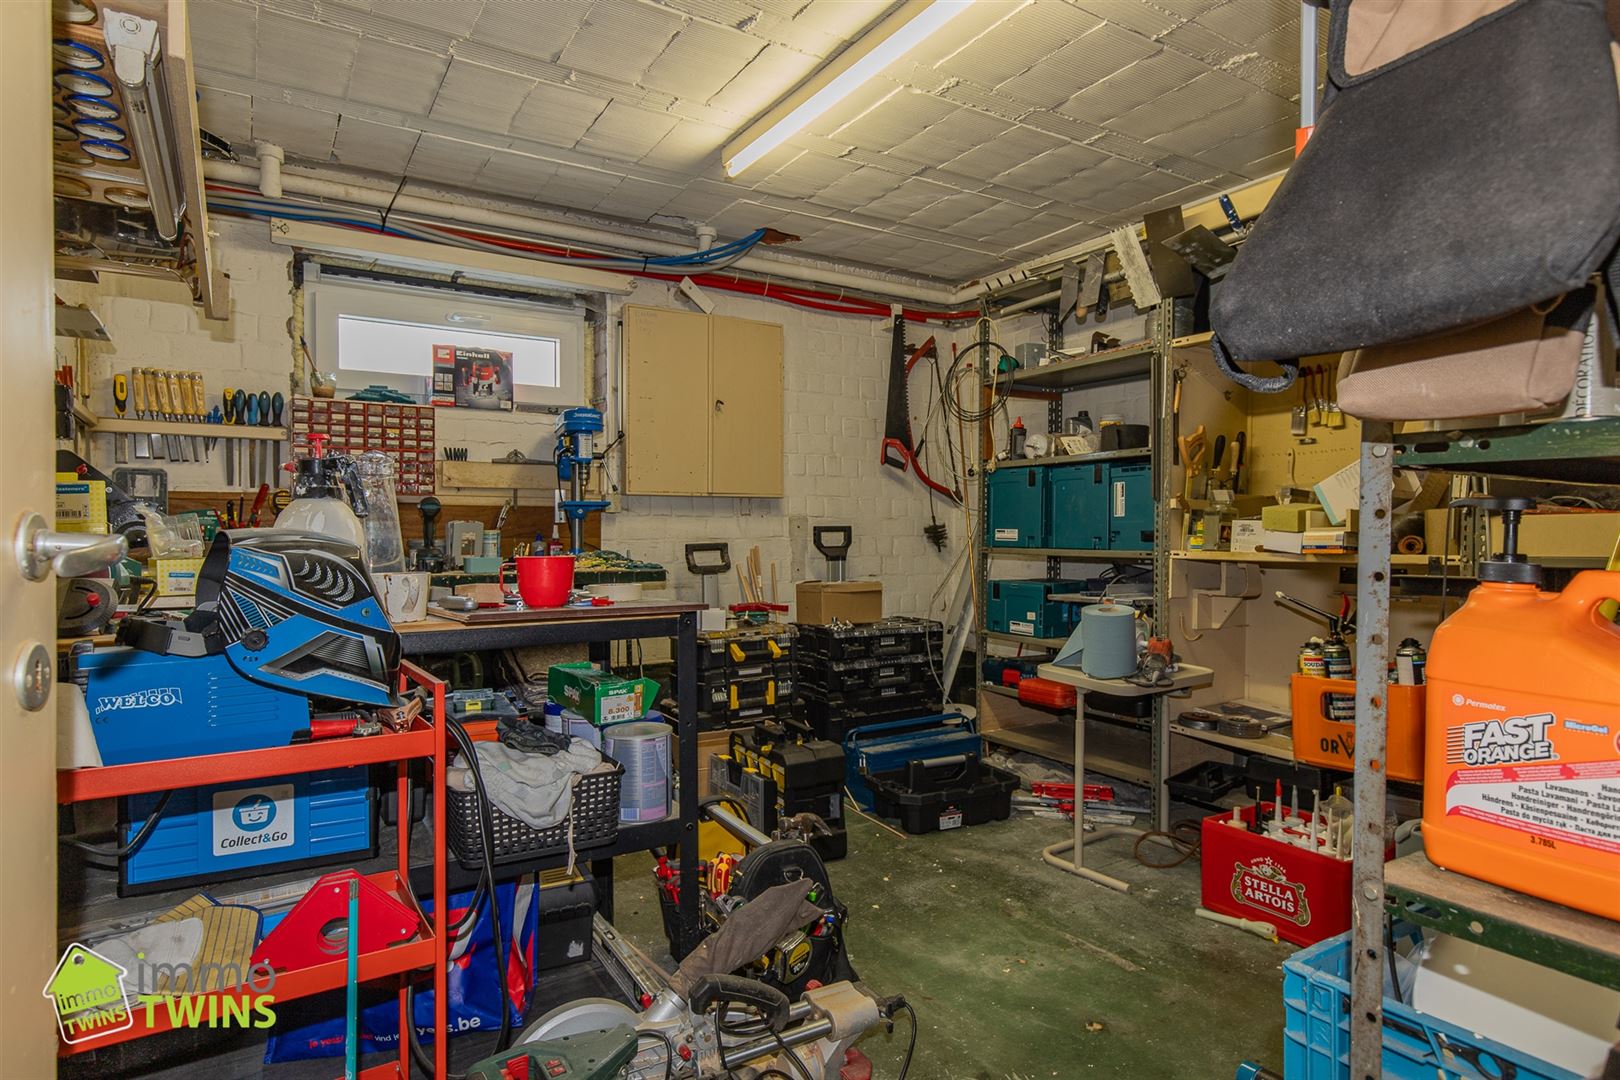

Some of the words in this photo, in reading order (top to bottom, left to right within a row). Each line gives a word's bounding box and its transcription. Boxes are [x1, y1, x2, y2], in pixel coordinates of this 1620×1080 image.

[455, 350, 490, 359] Einhell
[96, 689, 180, 713] WELCO
[1463, 714, 1555, 751] FAST
[1462, 742, 1553, 767] ORANGE
[1518, 785, 1540, 797] Pasta
[1541, 790, 1579, 805] Lavamani
[1586, 799, 1610, 811] Pasta
[1544, 782, 1589, 798] Lavamanos
[1511, 792, 1560, 810] Handreiniger
[1500, 806, 1520, 818] Pasta
[1521, 811, 1532, 820] do
[1532, 815, 1555, 827] mycia
[220, 831, 288, 849] Collect&Go
[1530, 835, 1557, 850] 3.785L
[1244, 875, 1294, 902] STELLA
[1244, 887, 1295, 913] ARTOIS
[415, 1016, 481, 1036] yes.be
